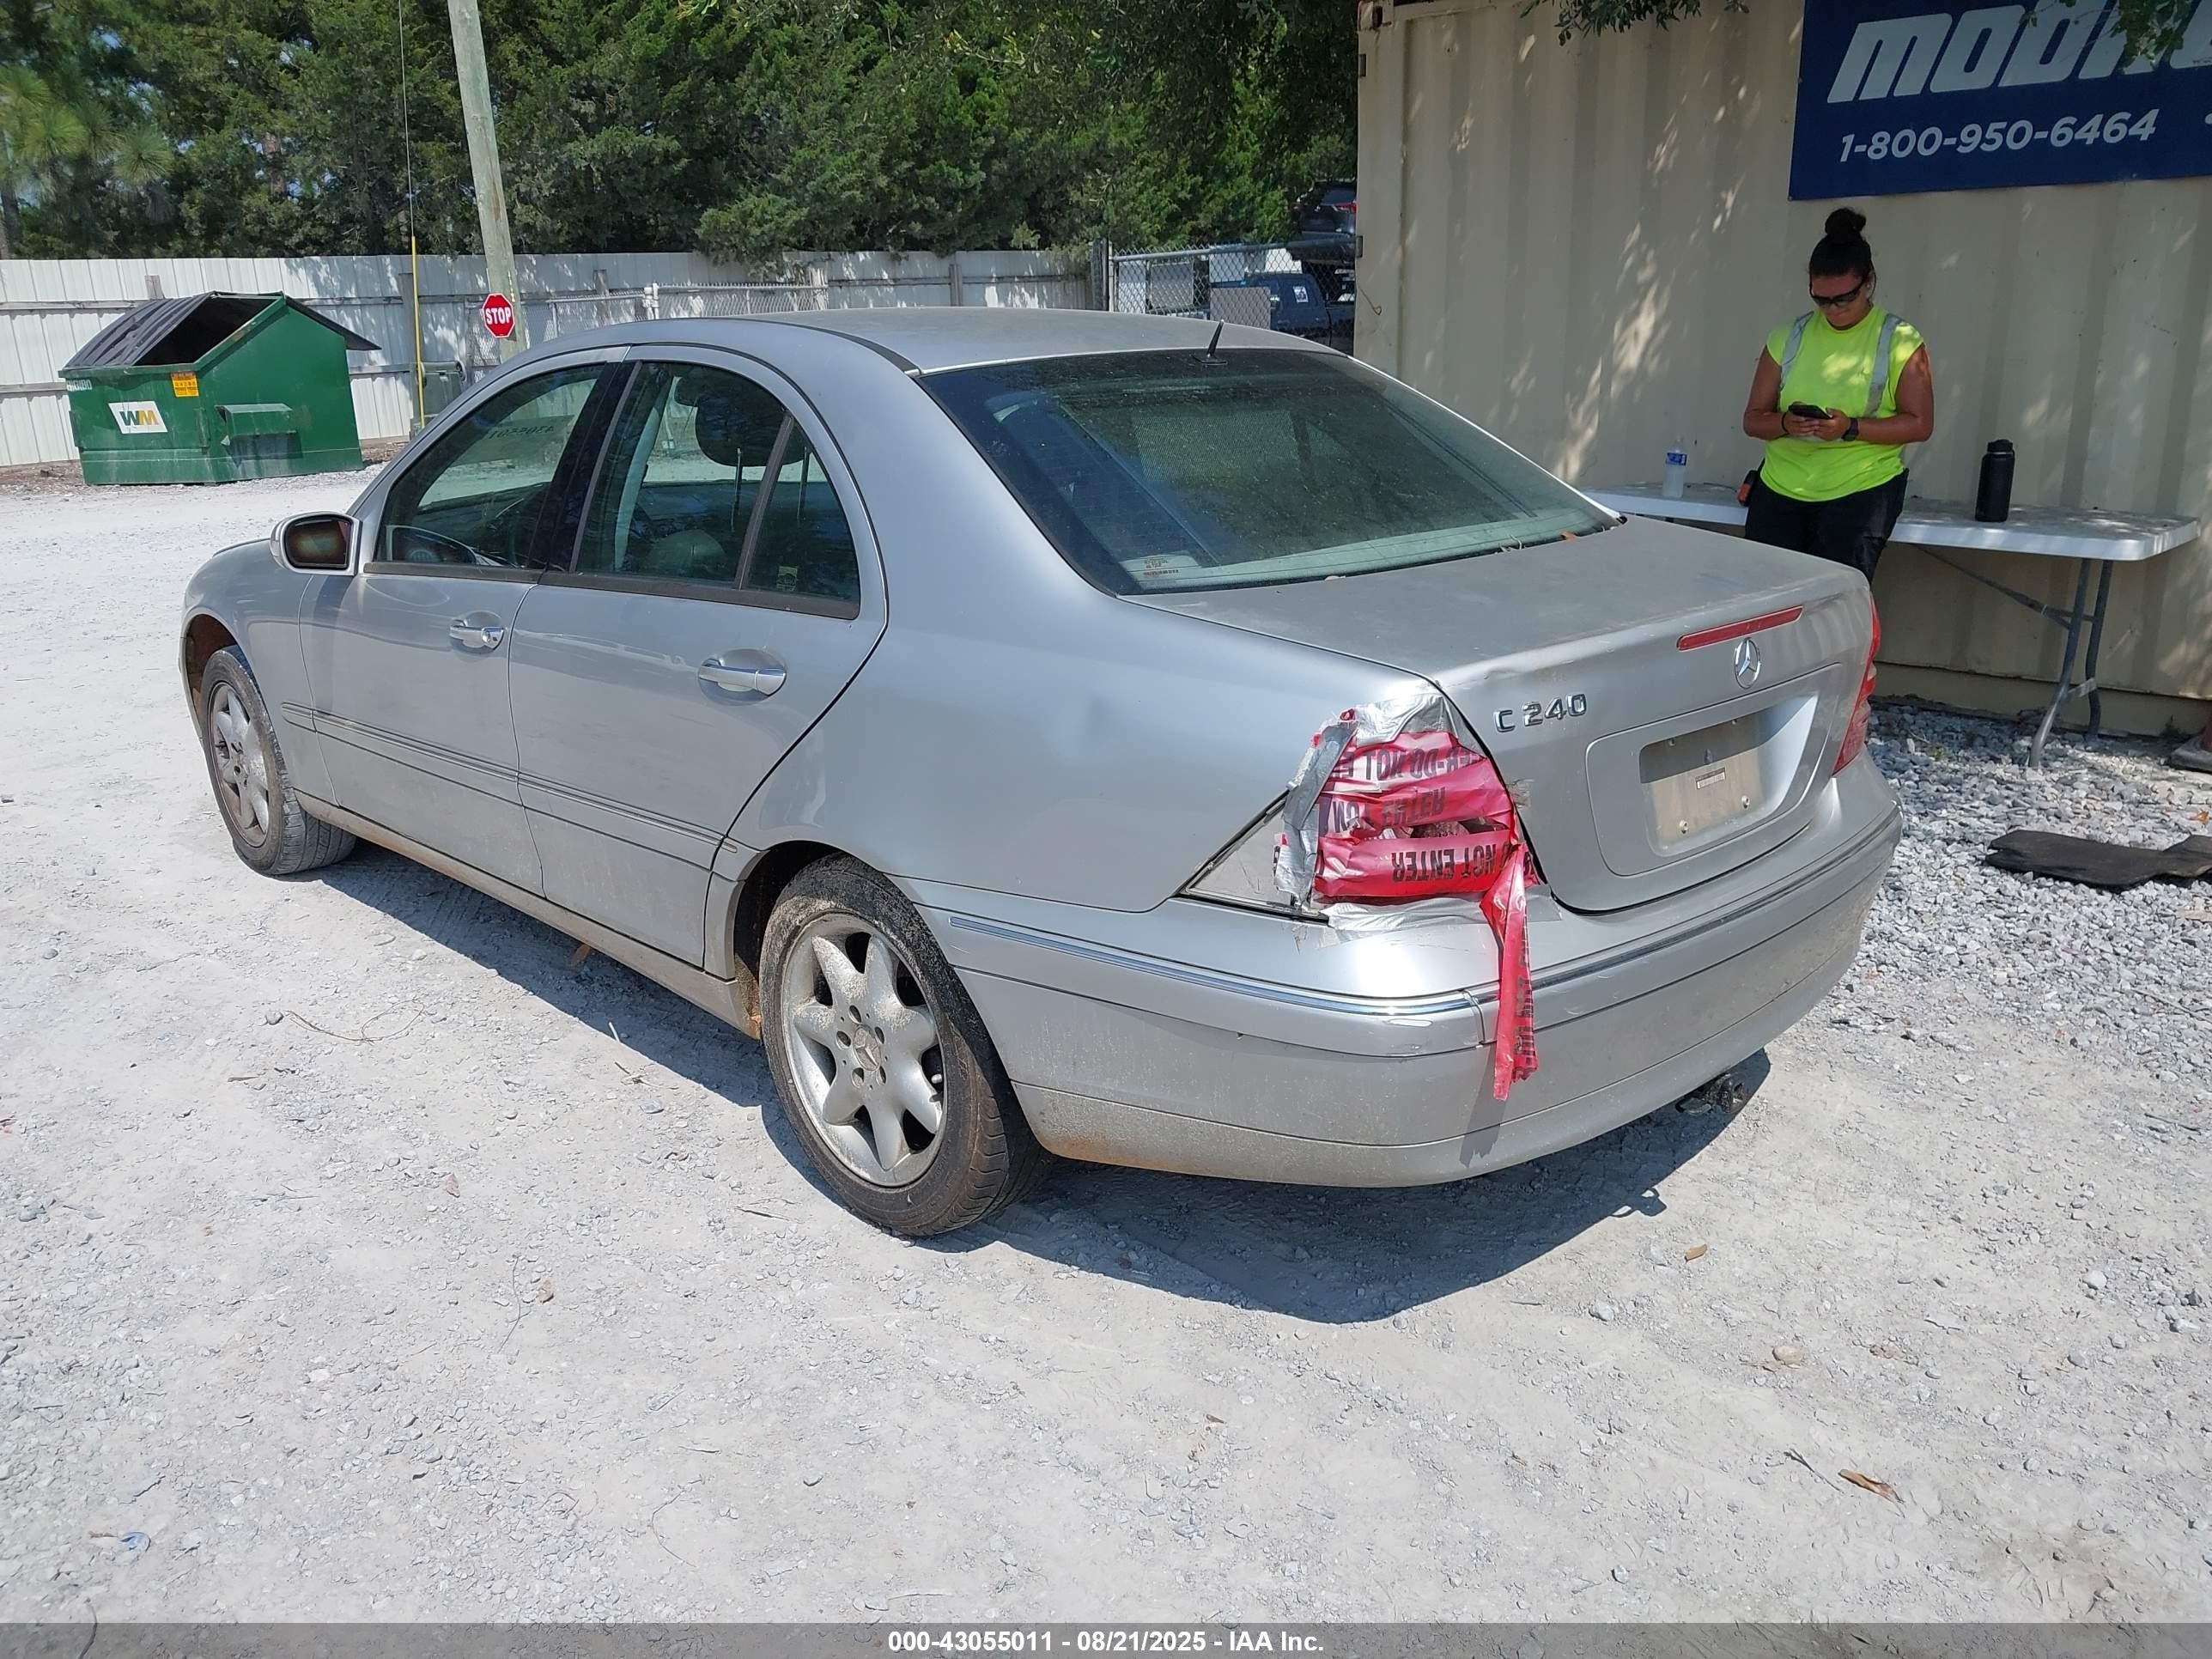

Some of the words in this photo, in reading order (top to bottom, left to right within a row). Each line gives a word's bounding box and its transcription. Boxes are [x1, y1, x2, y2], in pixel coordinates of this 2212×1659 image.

[1839, 108, 2160, 162] 1-800-950-6464
[485, 307, 512, 325] STOP
[119, 410, 159, 427] WM
[1494, 708, 1516, 732] C
[1522, 693, 1588, 727] 240
[1391, 848, 1455, 883] ENTER
[1462, 844, 1496, 878] NOT
